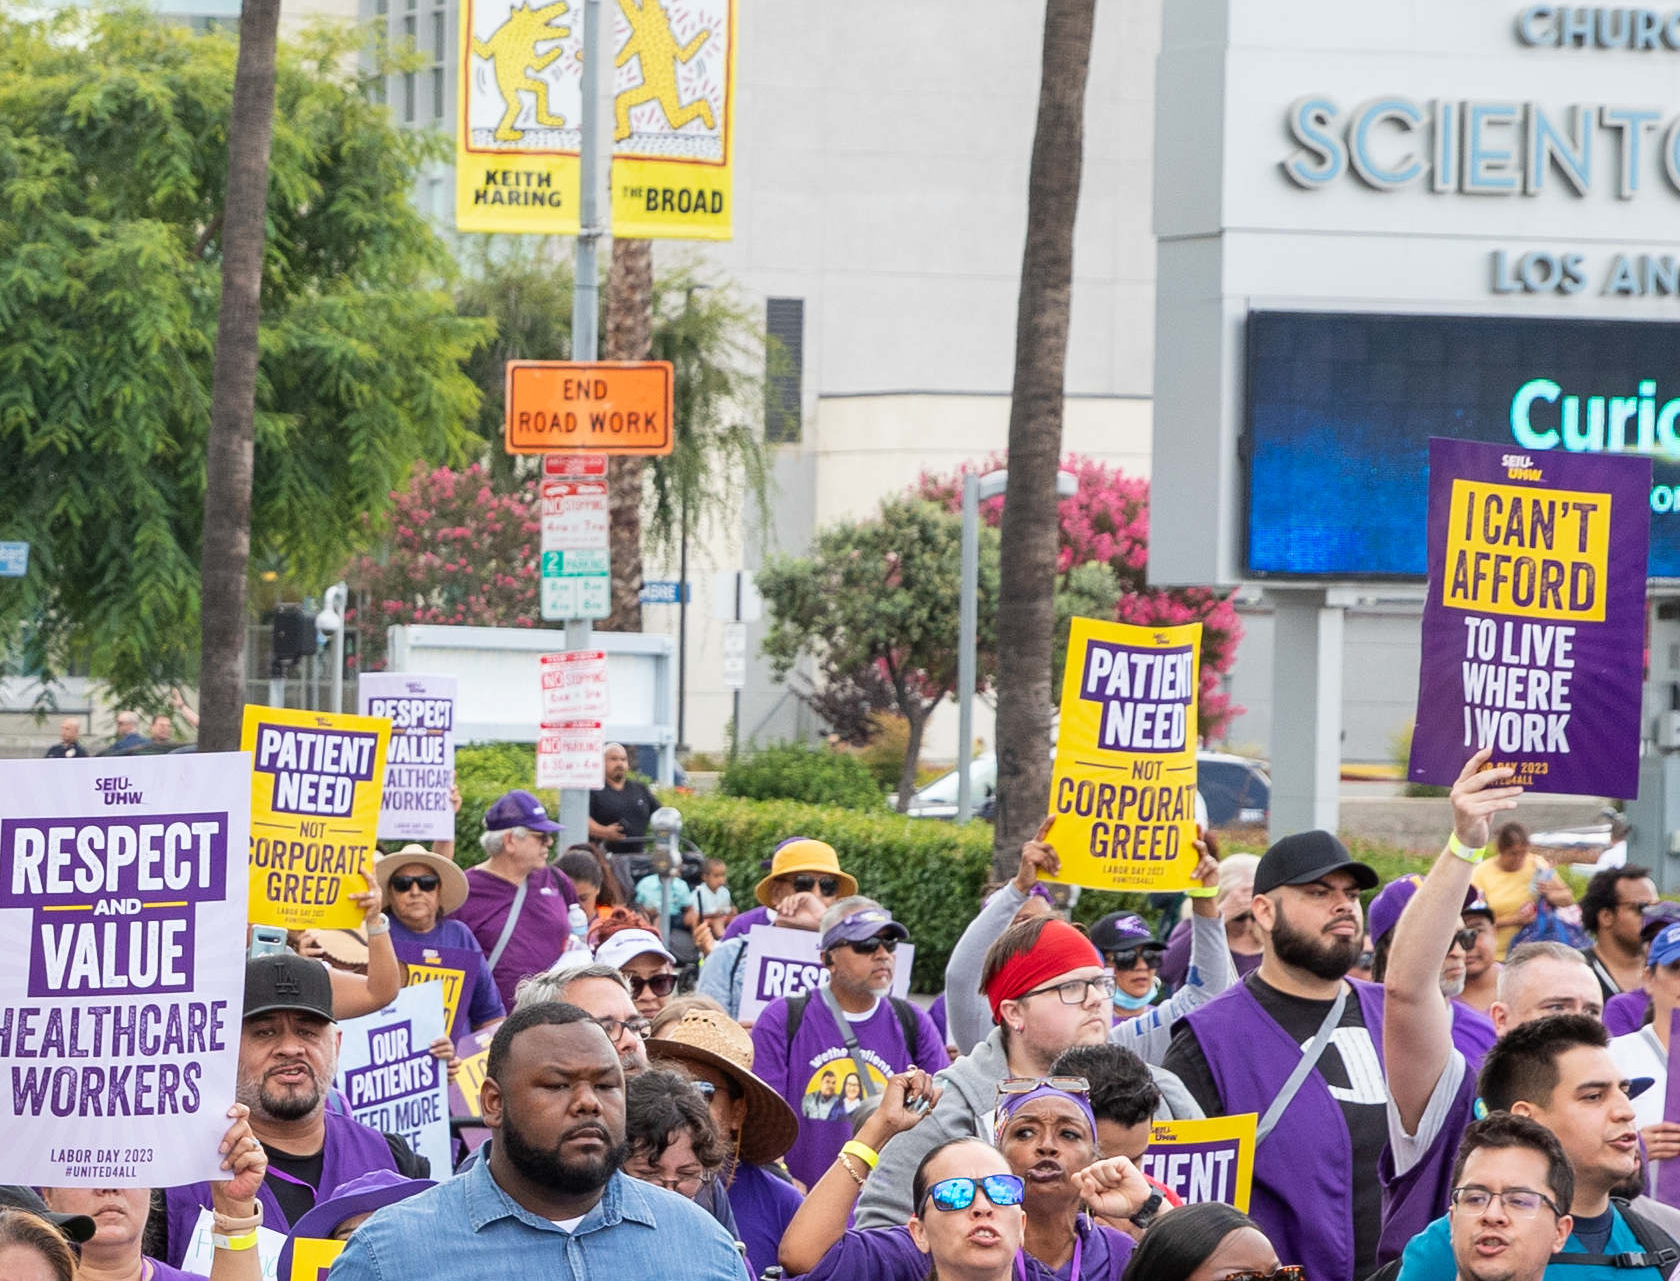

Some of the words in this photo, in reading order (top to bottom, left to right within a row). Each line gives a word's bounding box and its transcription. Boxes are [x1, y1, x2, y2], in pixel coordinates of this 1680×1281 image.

[485, 170, 552, 188] KEITH
[474, 189, 561, 207] HARING
[646, 189, 723, 213] BROAD
[1489, 249, 1587, 295] LOS
[563, 379, 608, 400] END
[519, 411, 577, 432] ROAD
[590, 411, 657, 432] WORK
[545, 497, 563, 513] NO
[1484, 493, 1597, 553] CAN'T
[548, 553, 558, 569] 2
[1452, 549, 1596, 611] AFFORD
[1465, 616, 1496, 660] TO
[1502, 622, 1576, 667] LIVE
[543, 672, 563, 687] NO
[1463, 662, 1572, 711] WHERE
[1102, 702, 1186, 747] NEED
[1477, 710, 1570, 753] WORK
[261, 731, 375, 776] PATIENT
[541, 737, 560, 753] NO
[277, 772, 352, 814] NEED
[10, 822, 219, 895] RESPECT
[1090, 822, 1179, 861] GREED
[267, 872, 341, 904] GREED
[93, 899, 142, 915] AND
[39, 921, 187, 990] VALUE
[10, 1061, 202, 1118] WORKERS
[49, 1148, 91, 1163] LABOR
[96, 1148, 120, 1163] DAY
[123, 1148, 154, 1163] 2023
[65, 1165, 137, 1178] #UNITED4ALL
